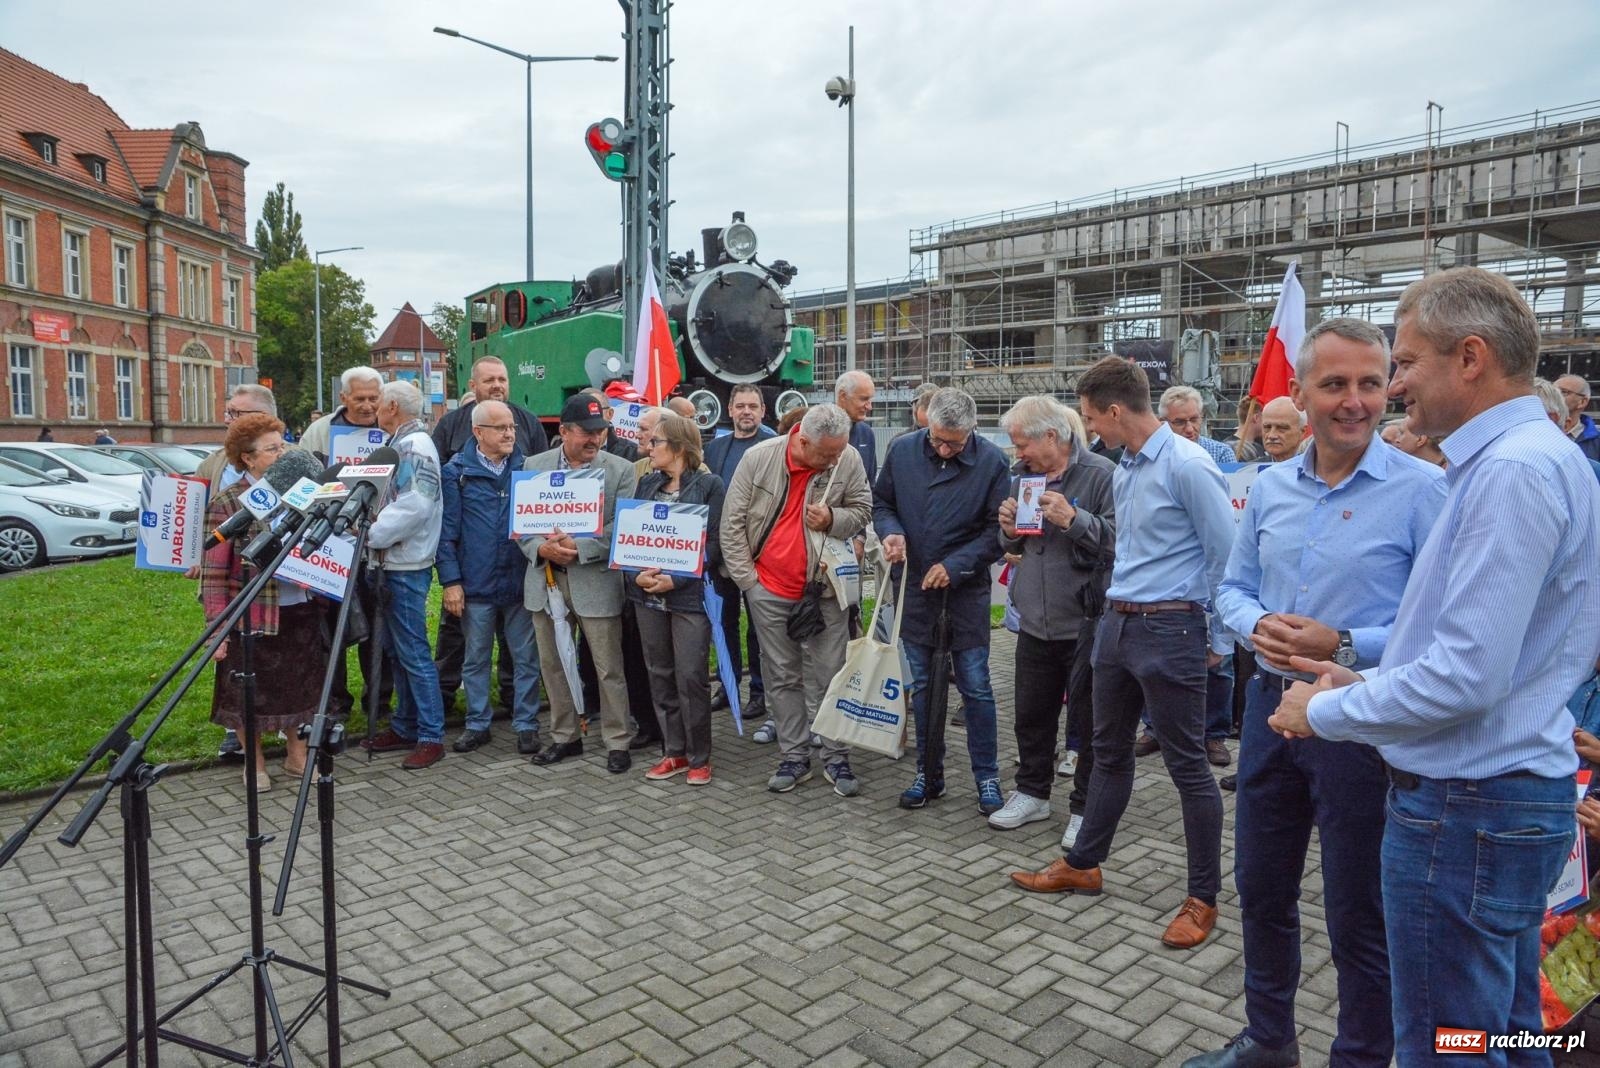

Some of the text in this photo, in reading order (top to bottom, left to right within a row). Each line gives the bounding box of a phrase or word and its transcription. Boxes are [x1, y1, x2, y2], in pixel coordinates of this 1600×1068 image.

[540, 491, 576, 500] PAWEŁ
[516, 500, 597, 514] JABŁOŃSKI
[161, 502, 172, 540] PAWEŁ
[171, 481, 188, 565] JABŁOŃSKI
[194, 515, 199, 524] DO
[641, 523, 678, 534] PAWEŁ
[191, 526, 199, 559] KANDYDAT
[617, 534, 699, 551] JABŁOŃSKI
[623, 554, 656, 562] KANDYDAT
[667, 557, 689, 565] SEJMU!
[280, 563, 310, 577] ANDYDAT
[310, 574, 320, 582] DO
[883, 678, 900, 700] 5
[865, 710, 897, 722] MATUSIAK
